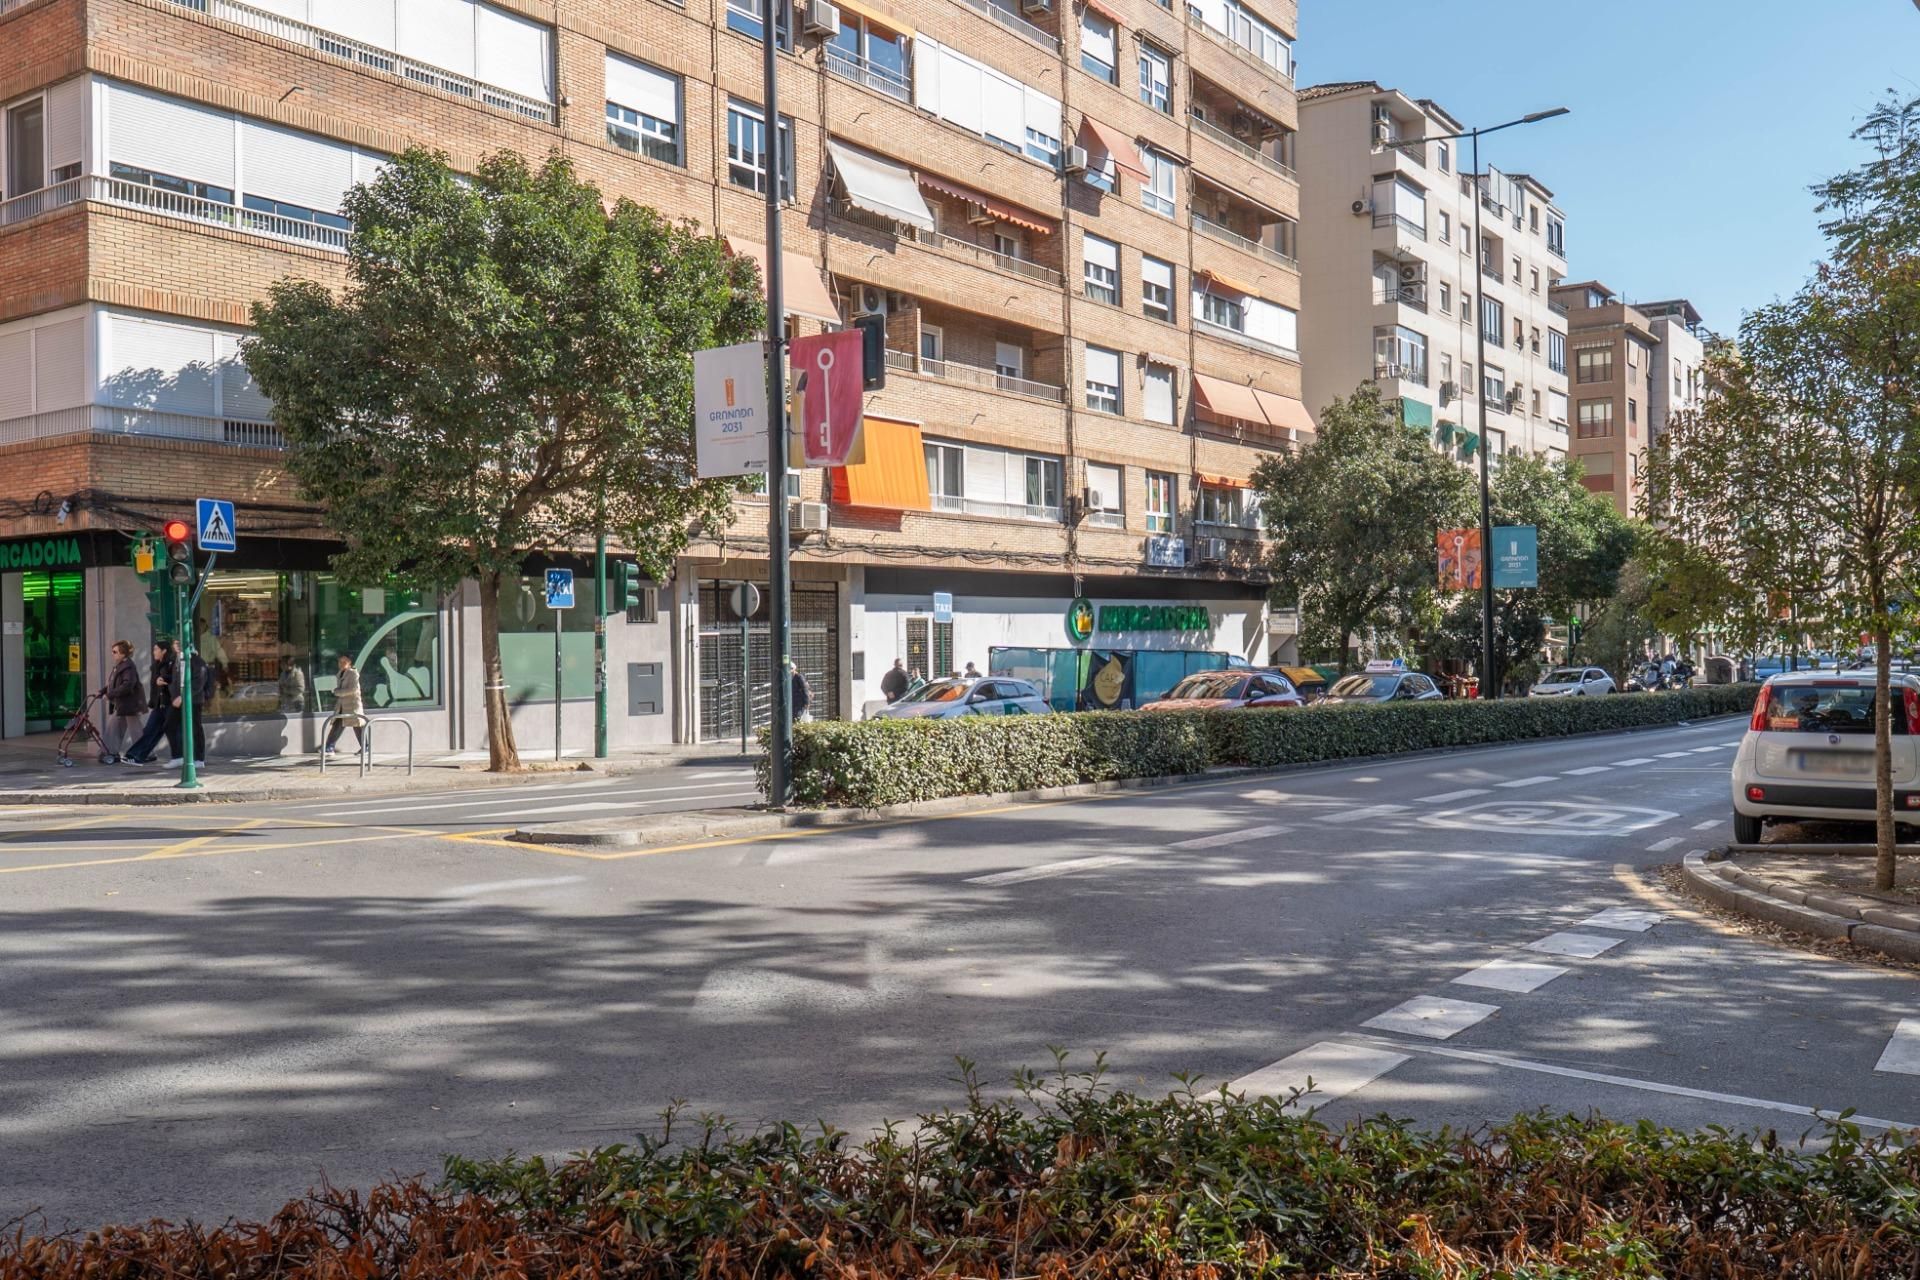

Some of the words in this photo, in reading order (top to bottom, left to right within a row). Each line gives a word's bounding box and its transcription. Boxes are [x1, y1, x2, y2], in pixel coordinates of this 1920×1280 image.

[709, 407, 754, 421] GRANADA
[722, 421, 743, 432] 2031
[935, 603, 952, 612] TAXI
[1099, 605, 1211, 631] MERCADONA
